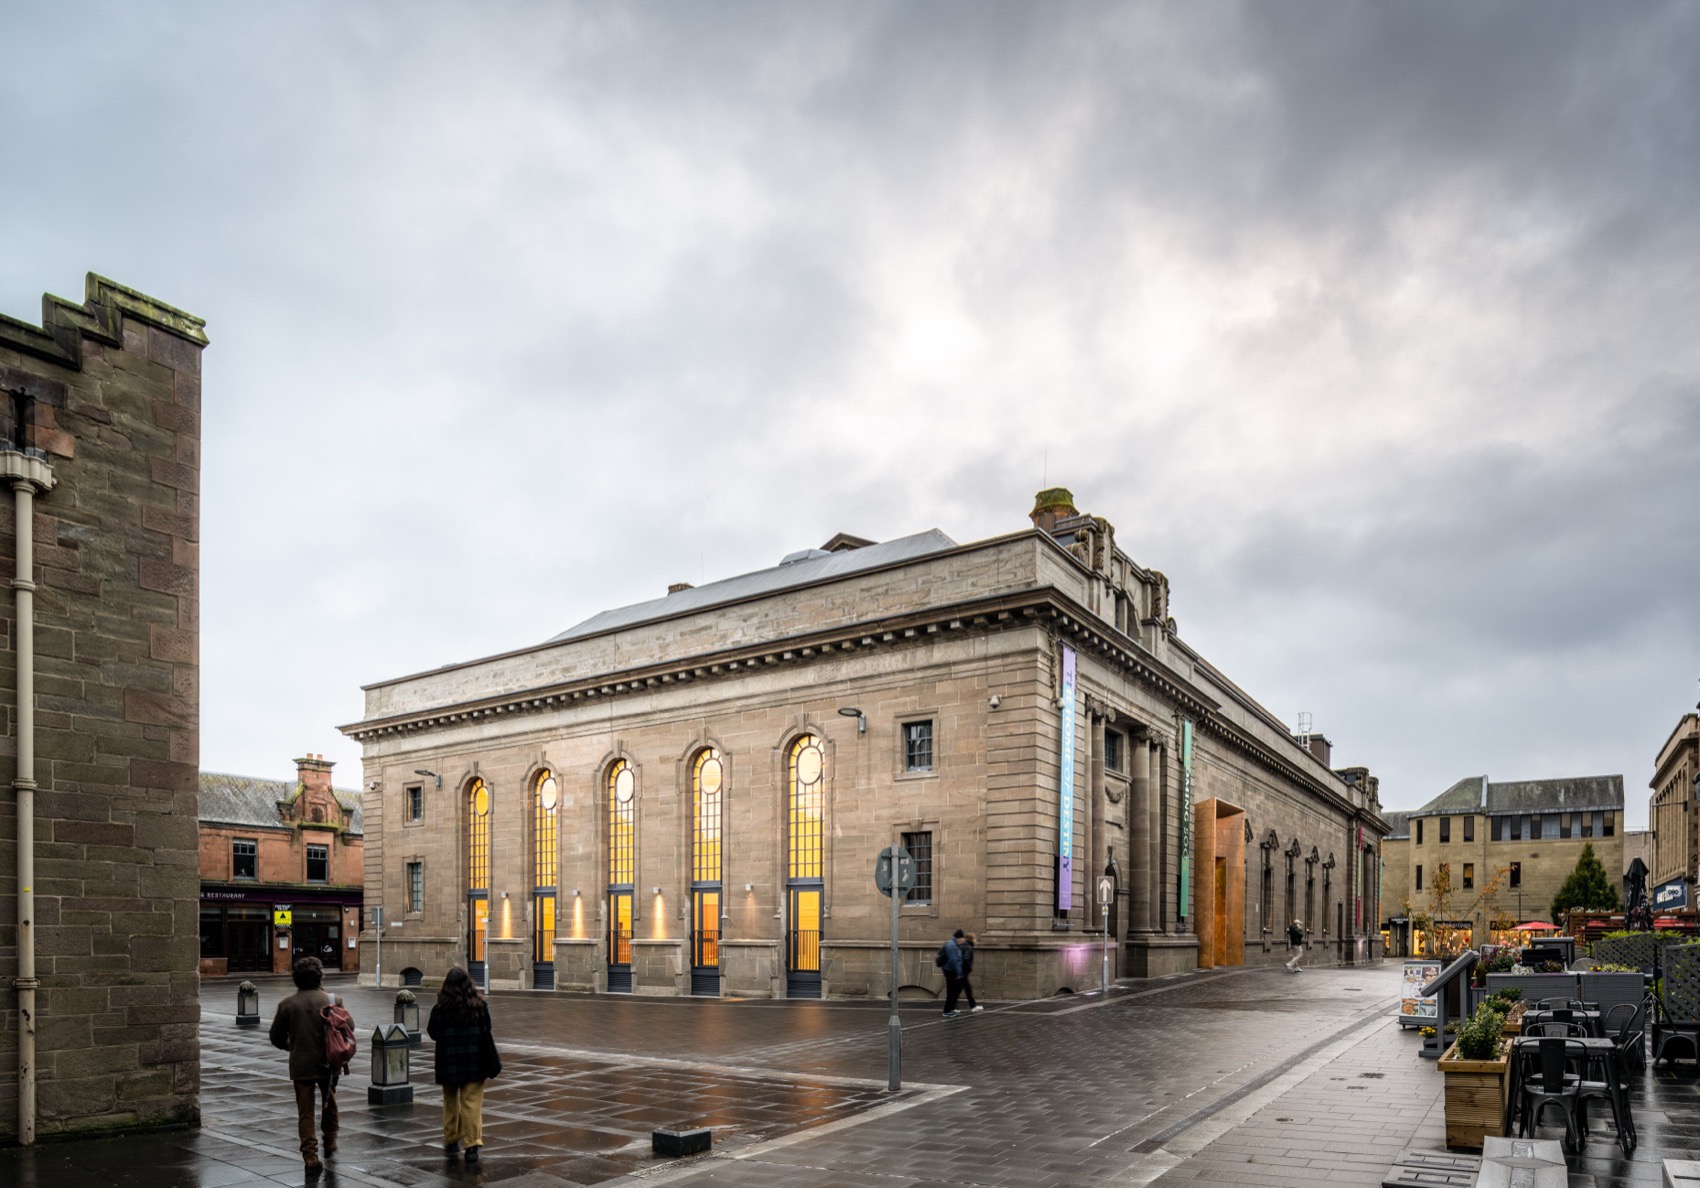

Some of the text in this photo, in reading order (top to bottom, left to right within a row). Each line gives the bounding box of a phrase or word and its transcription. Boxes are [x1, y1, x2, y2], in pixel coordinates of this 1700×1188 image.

[1064, 708, 1072, 763] HOME
[1063, 766, 1071, 790] OF
[1062, 795, 1070, 873] DESTINY
